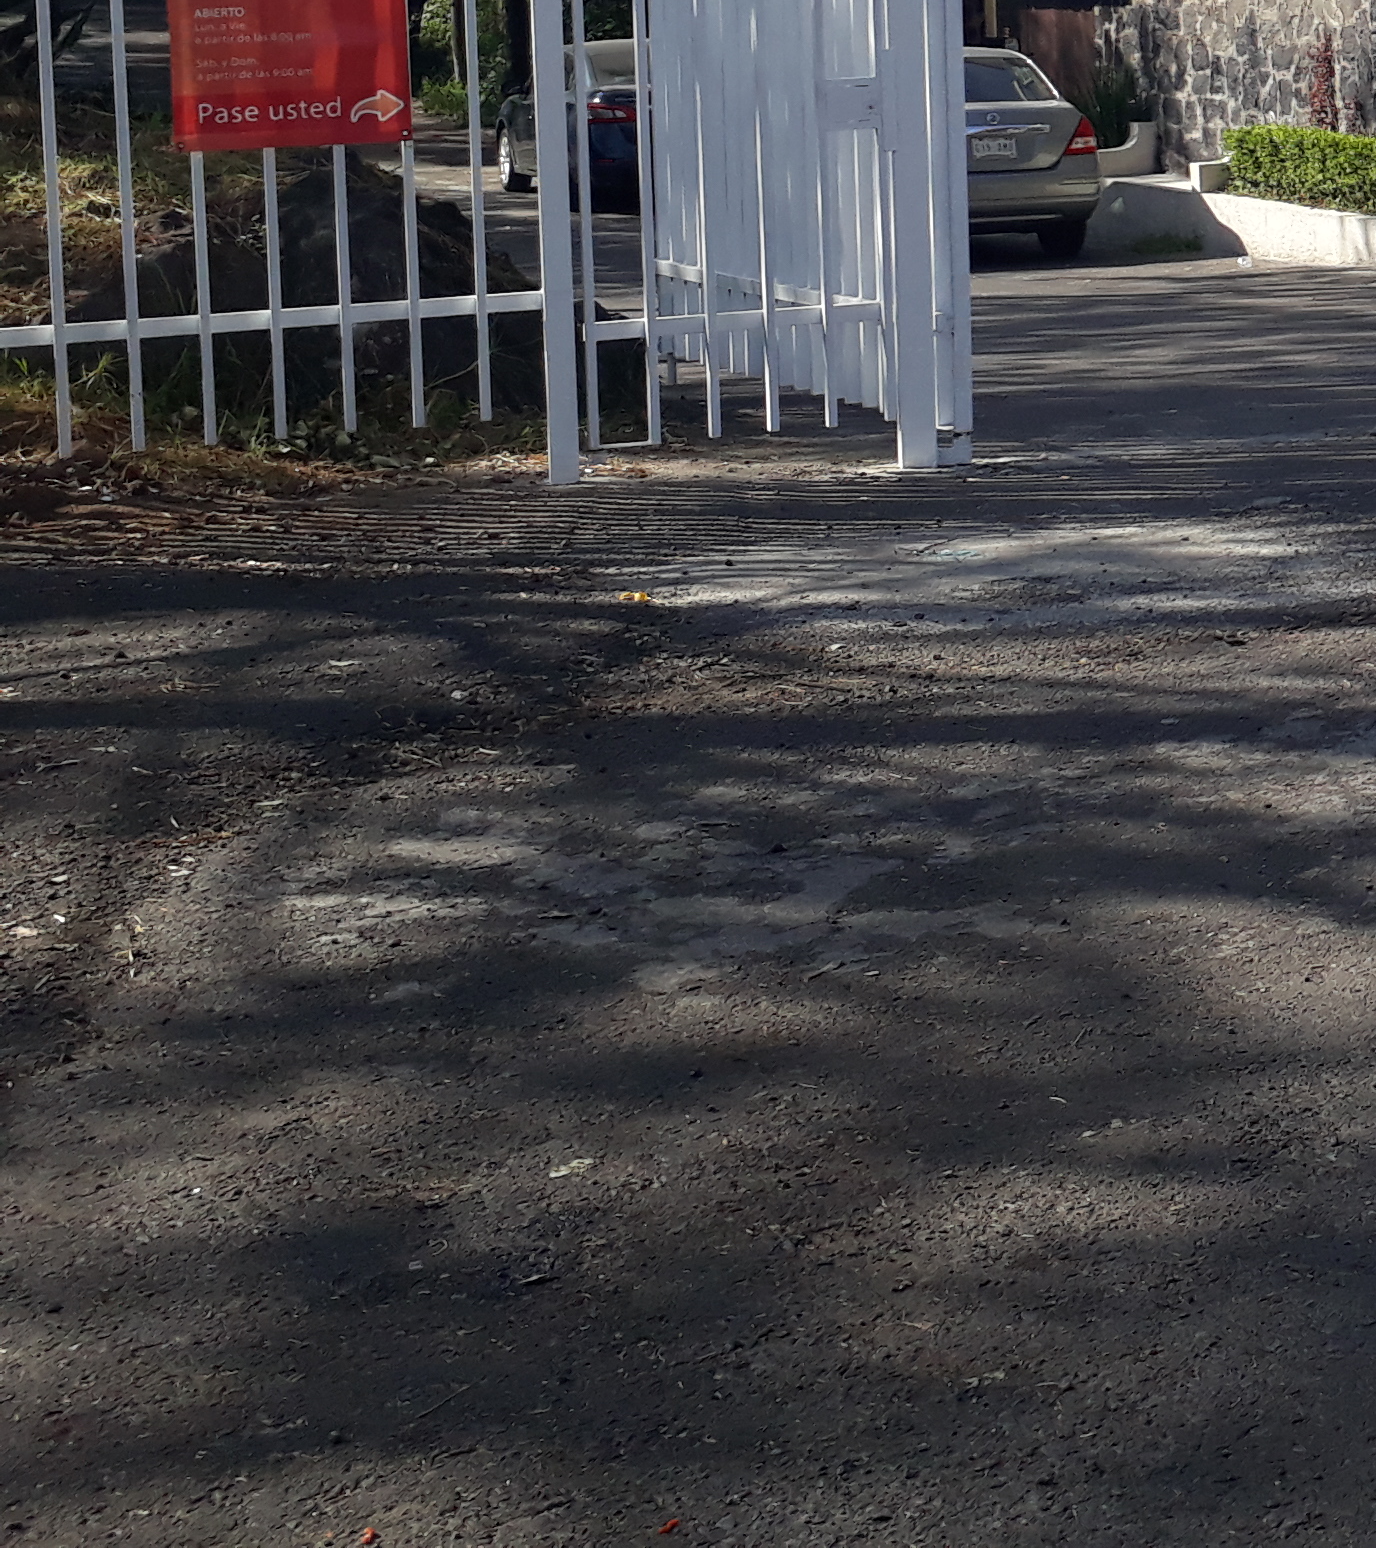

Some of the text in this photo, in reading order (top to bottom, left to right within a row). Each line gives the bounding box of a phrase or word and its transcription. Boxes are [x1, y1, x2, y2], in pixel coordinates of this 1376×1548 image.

[194, 7, 246, 18] ABIERTO
[198, 95, 342, 124] Pase usted
